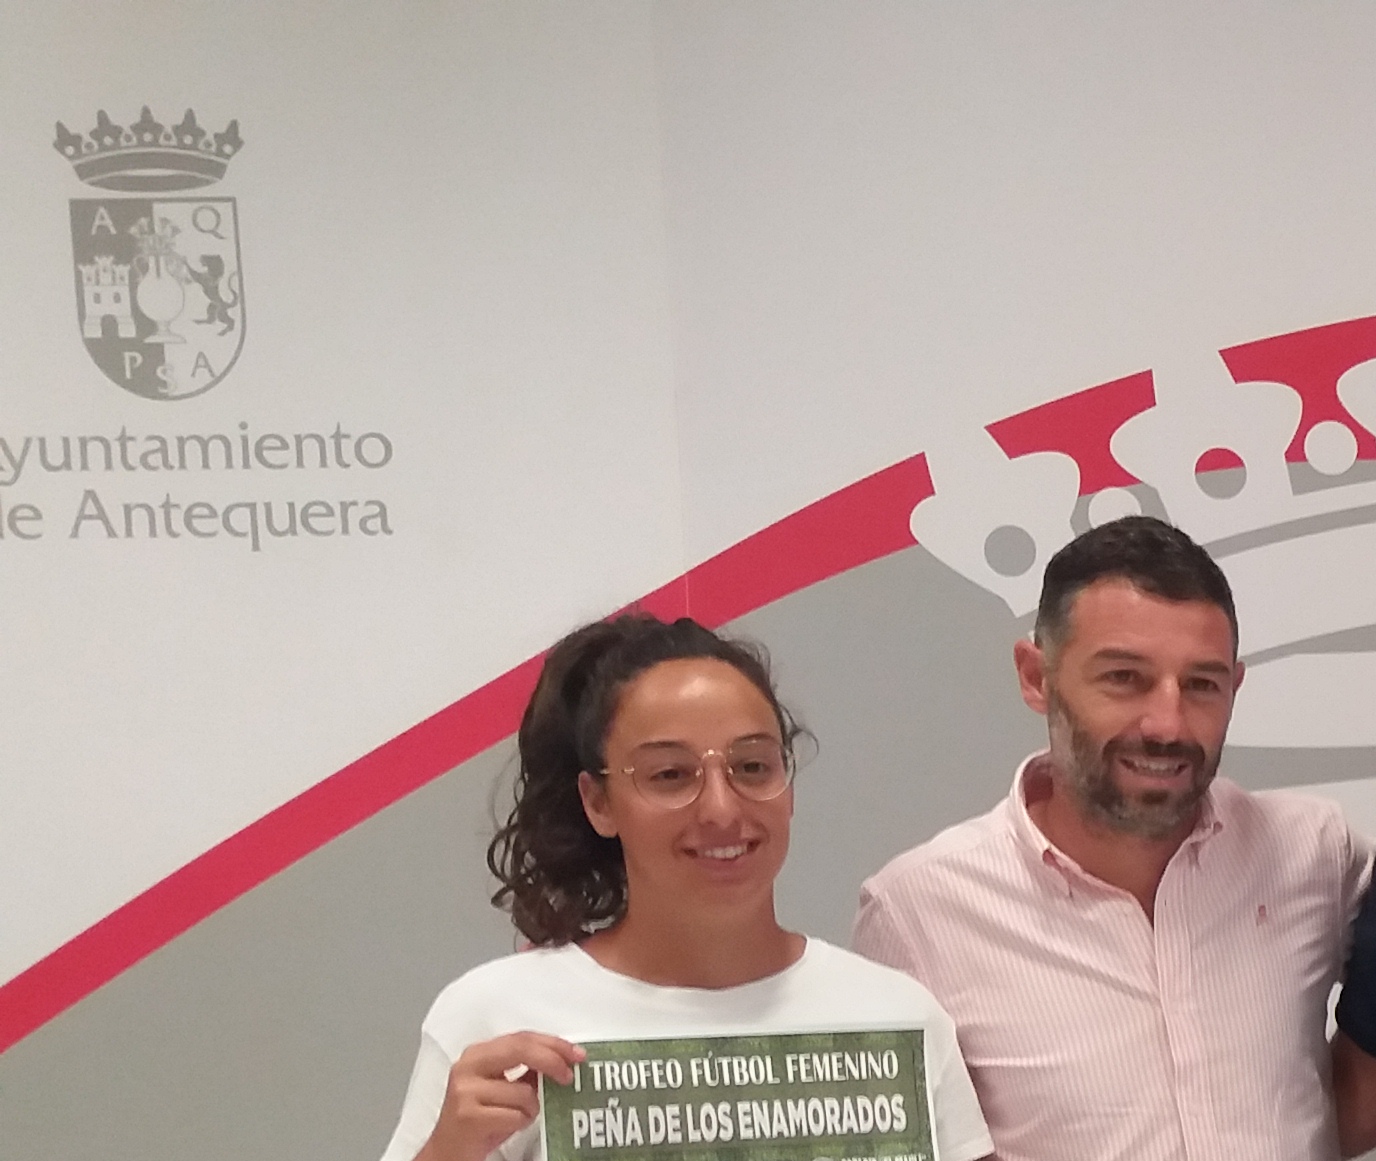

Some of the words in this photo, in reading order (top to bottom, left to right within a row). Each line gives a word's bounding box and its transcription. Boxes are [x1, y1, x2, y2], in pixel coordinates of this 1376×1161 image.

[0, 421, 394, 486] yuntamiento
[0, 494, 44, 540] e
[69, 489, 394, 552] Antequera
[573, 1064, 582, 1092] I
[588, 1058, 683, 1091] TROFEO
[690, 1051, 781, 1087] FÚTBOL
[785, 1049, 899, 1083] FEMENINO
[572, 1097, 644, 1150] PEÑA
[647, 1104, 683, 1145] DE
[685, 1101, 734, 1143] LOS
[736, 1093, 907, 1140] ENAMORADOS
